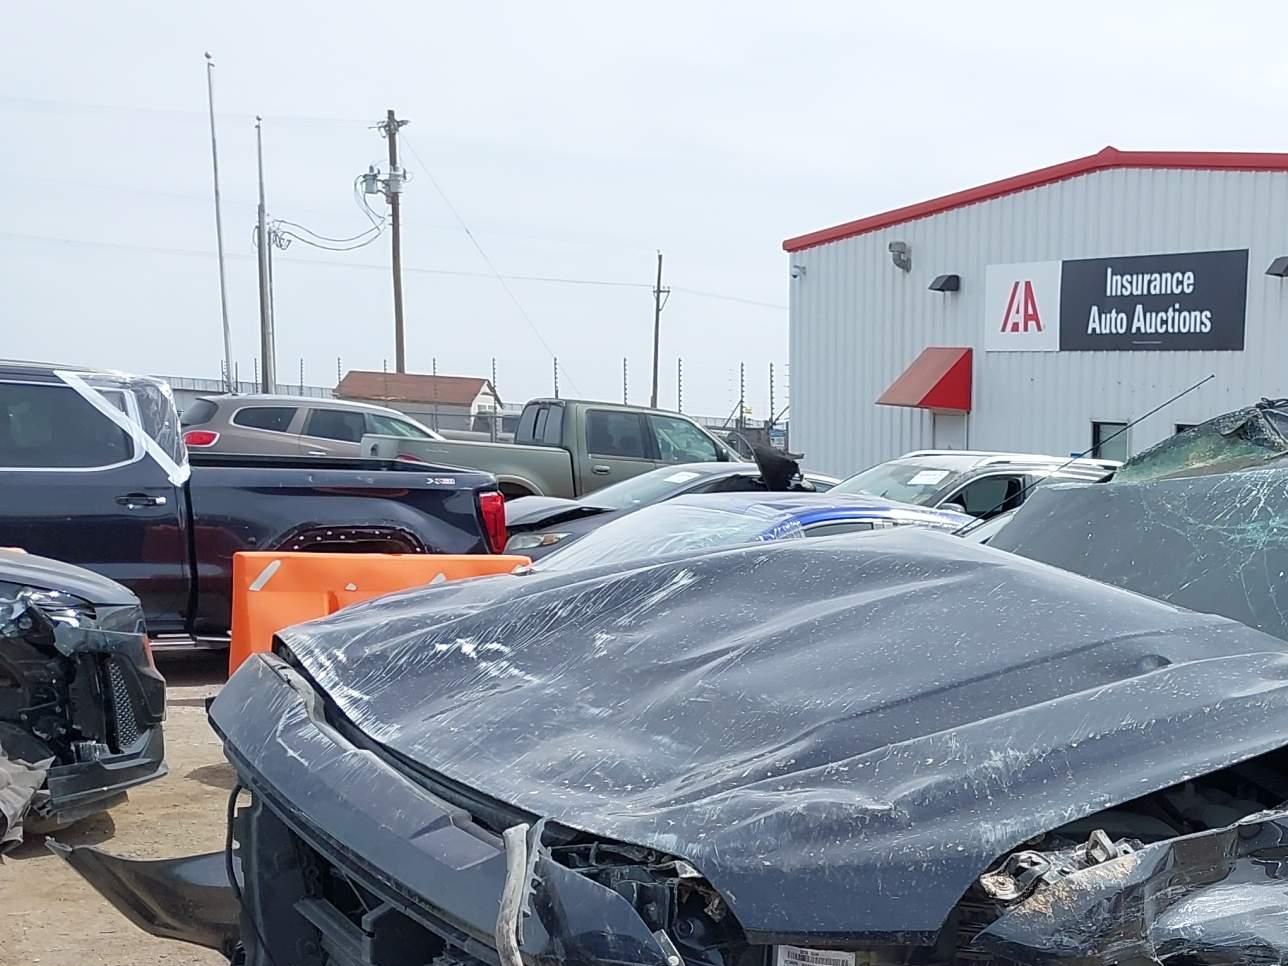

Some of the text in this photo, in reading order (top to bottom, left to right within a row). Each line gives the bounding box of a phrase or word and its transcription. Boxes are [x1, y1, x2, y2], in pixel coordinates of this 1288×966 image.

[1106, 267, 1195, 296] Insurance
[1087, 303, 1212, 334] Auto Auctions
